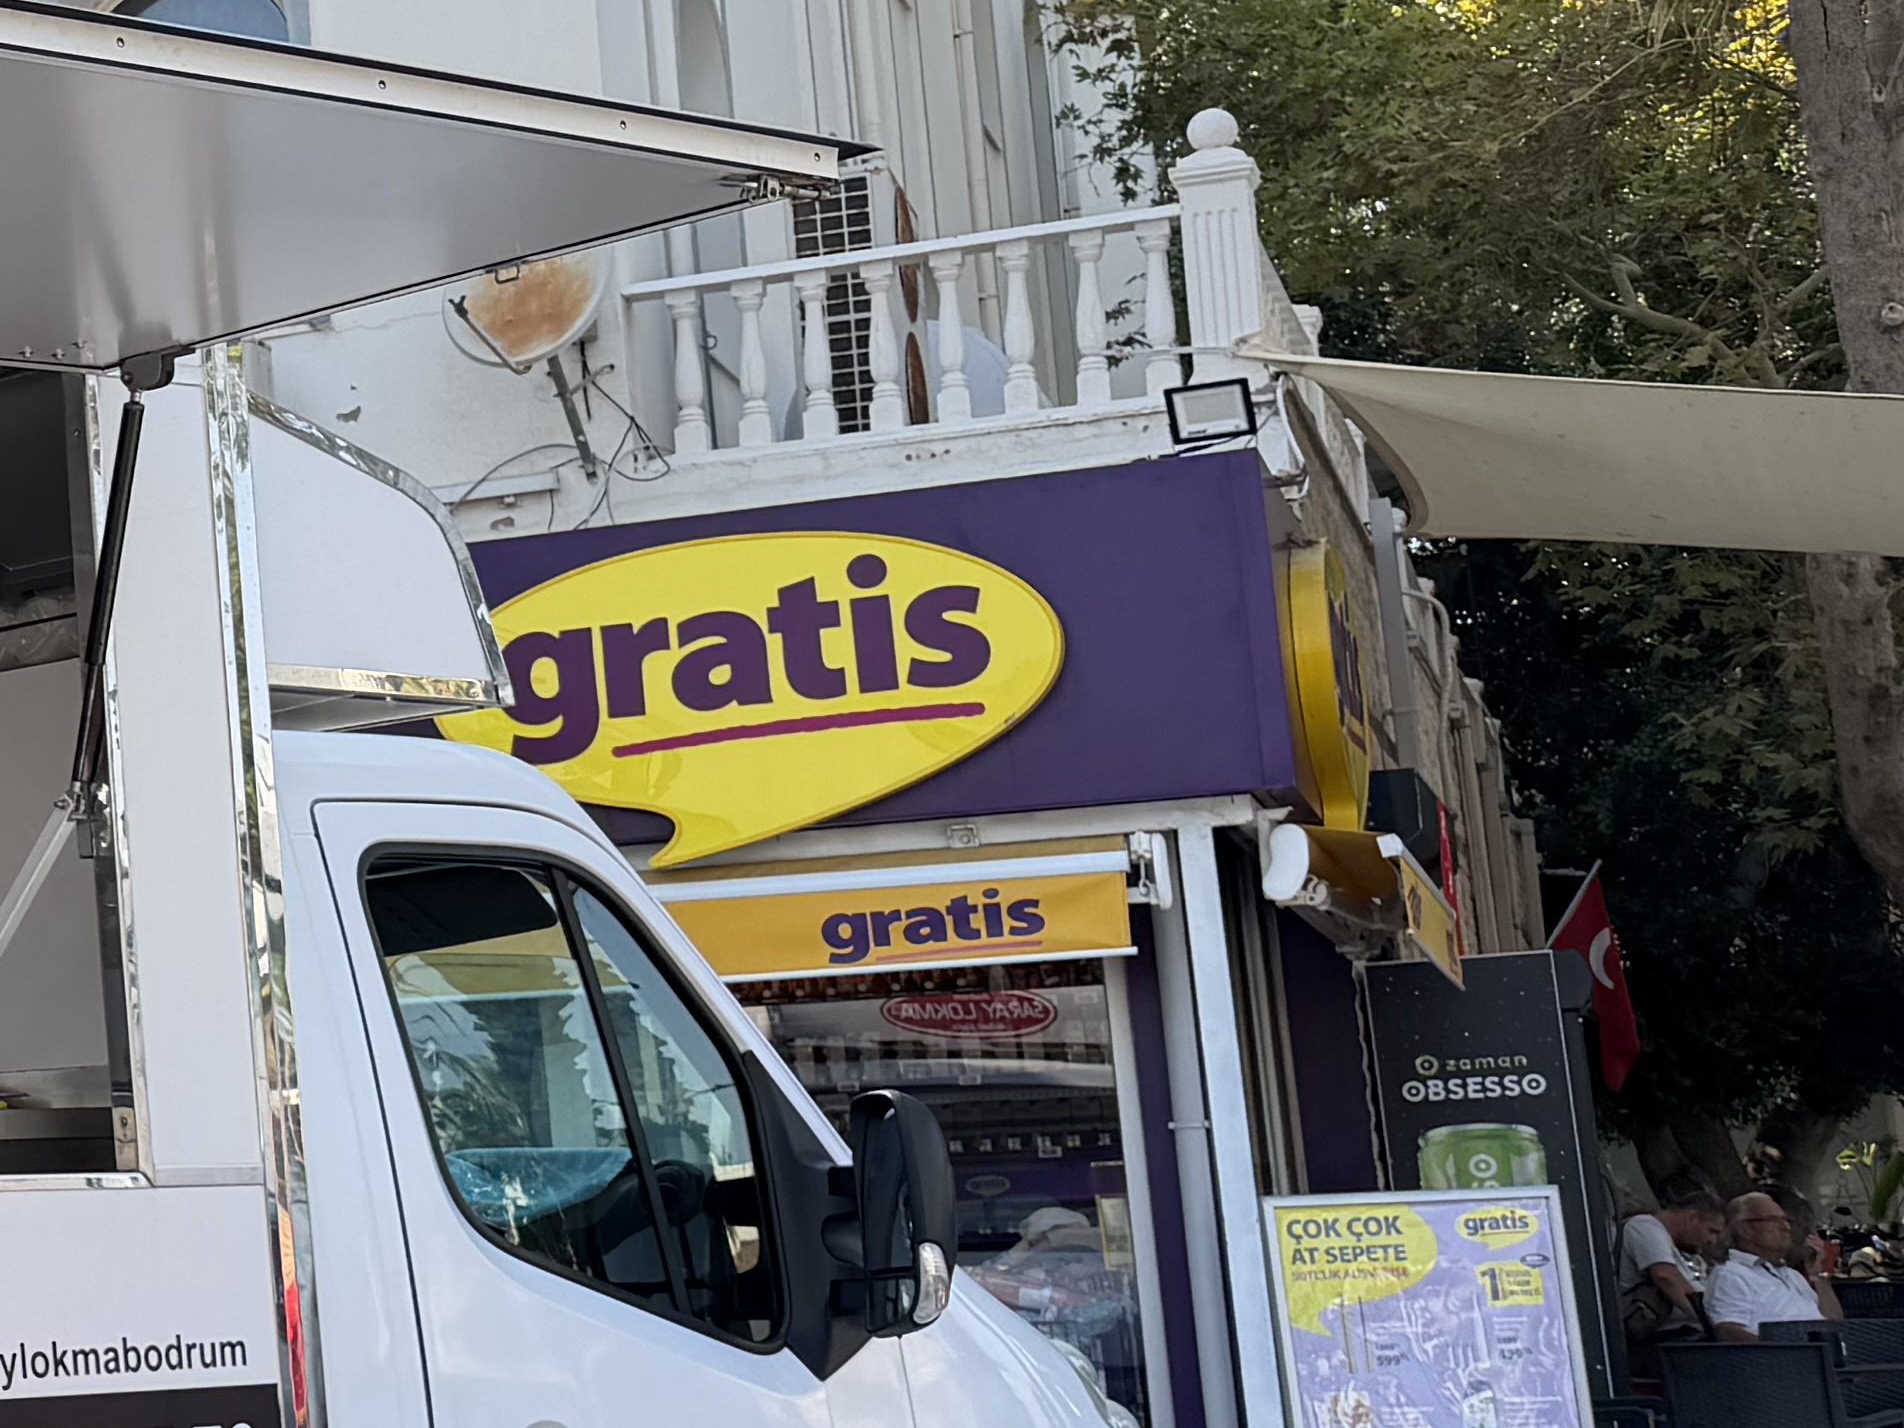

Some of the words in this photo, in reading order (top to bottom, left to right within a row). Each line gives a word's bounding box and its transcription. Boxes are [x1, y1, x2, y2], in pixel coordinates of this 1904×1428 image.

[503, 553, 992, 765] gratis
[821, 887, 1046, 965] gratis
[1445, 1054, 1528, 1071] zaman
[1401, 1073, 1547, 1103] OBSESSO
[1286, 1218, 1342, 1245] ÇOK
[1346, 1216, 1403, 1242] ÇOK
[1464, 1210, 1529, 1237] gratis
[1292, 1247, 1319, 1265] AT
[1324, 1244, 1408, 1264] SEPETE
